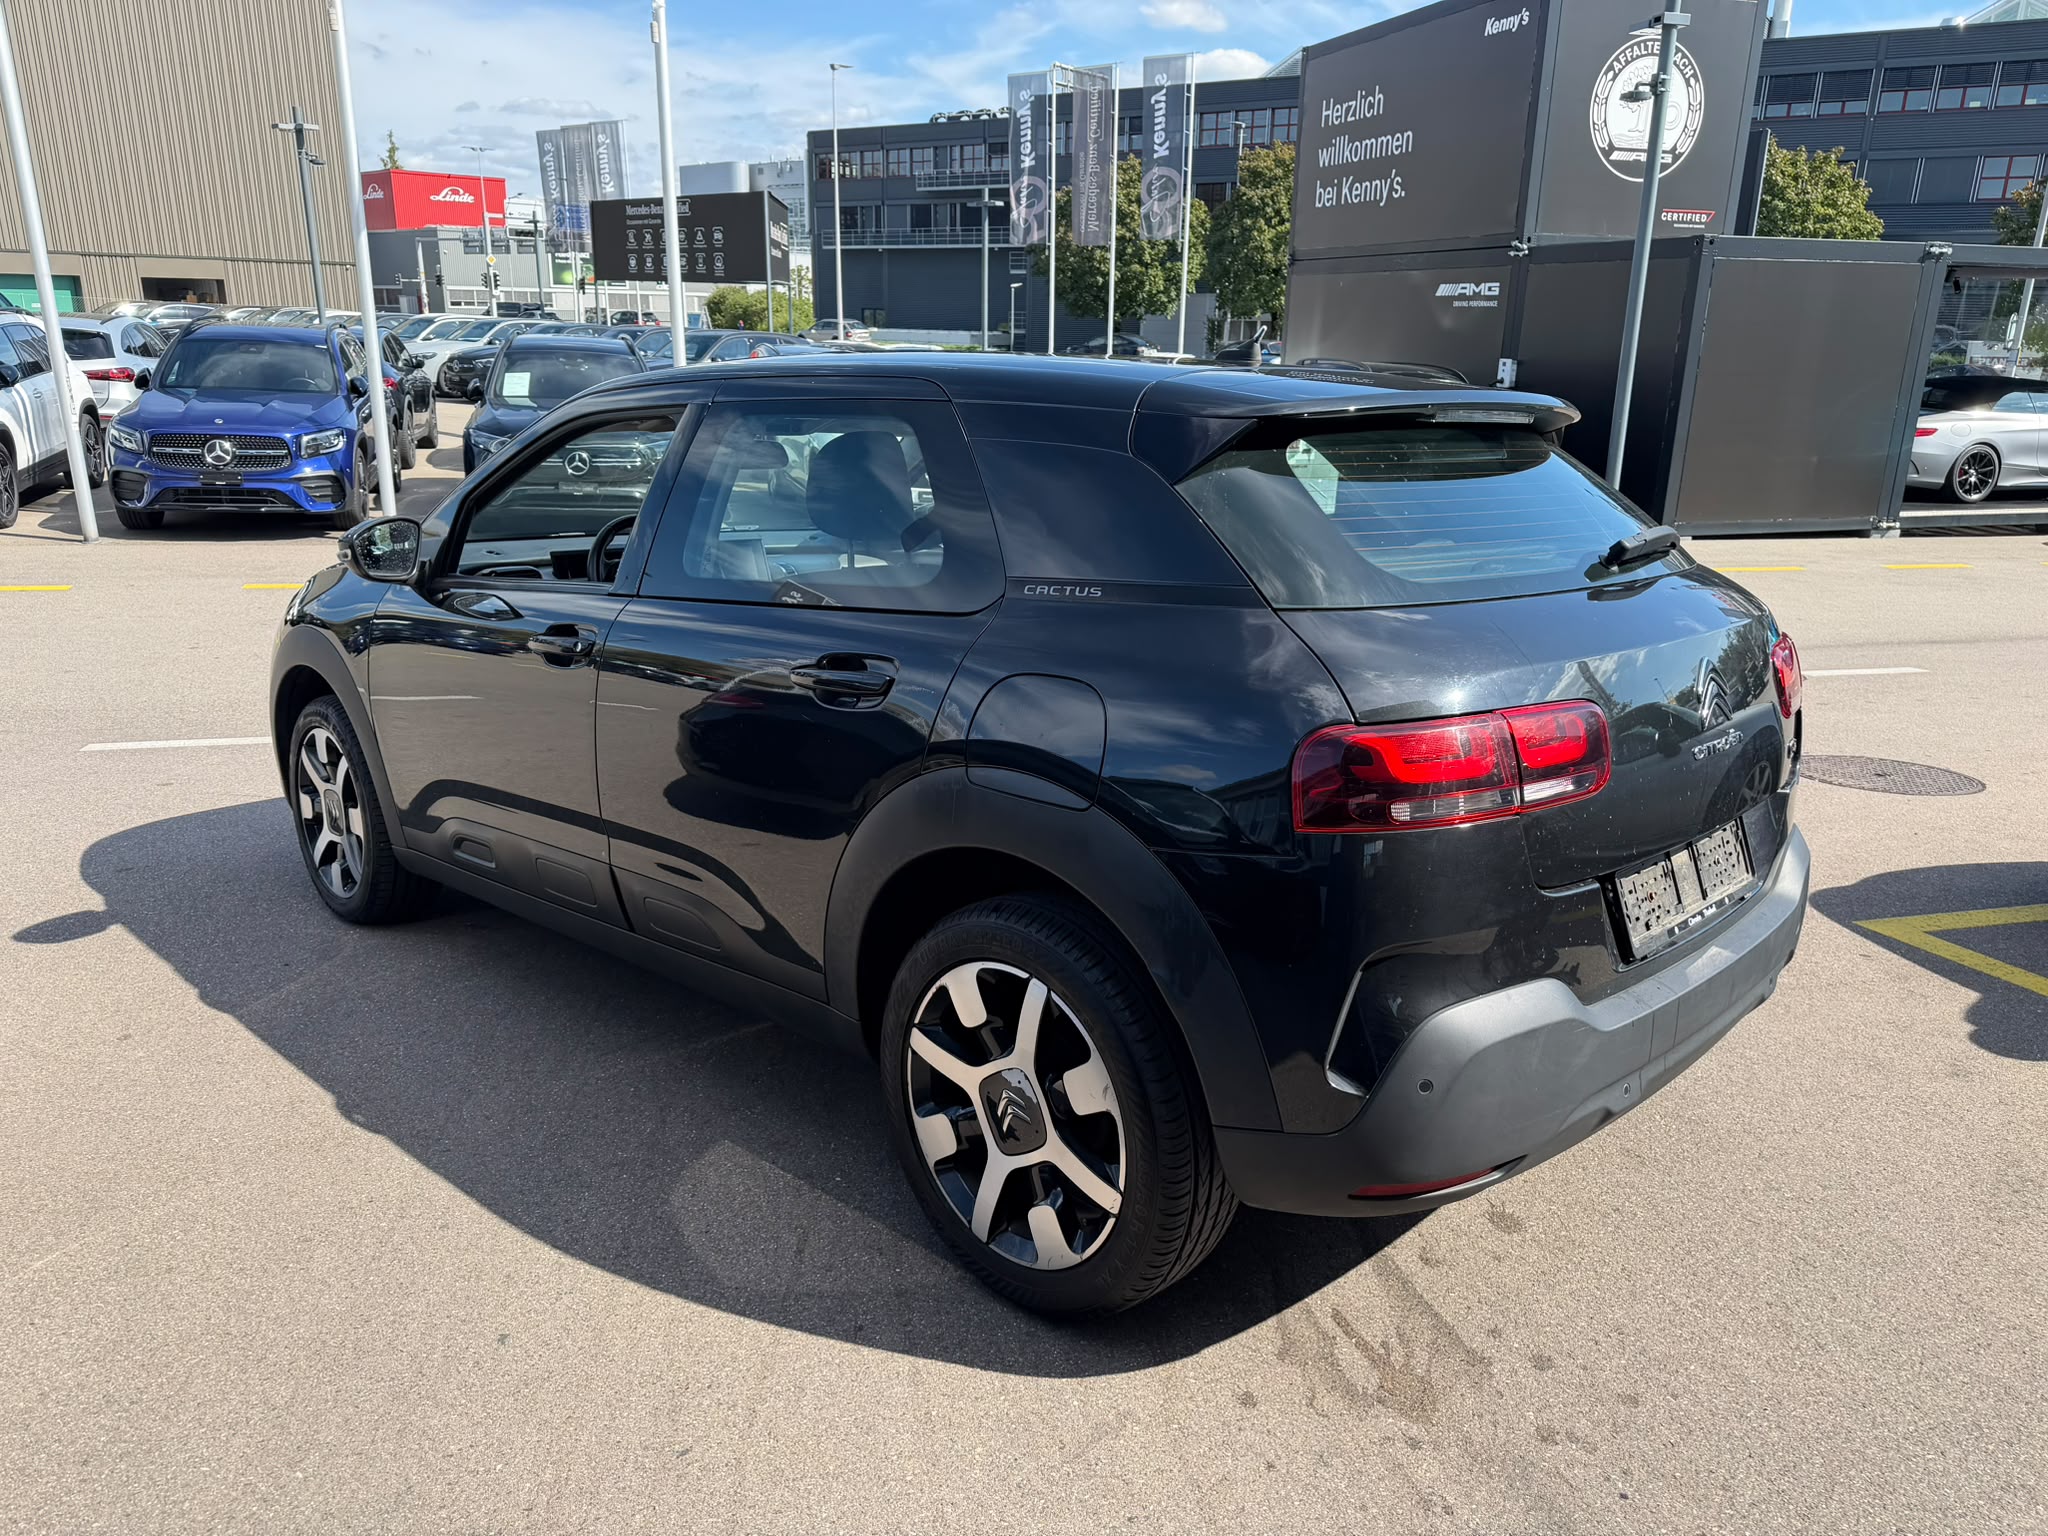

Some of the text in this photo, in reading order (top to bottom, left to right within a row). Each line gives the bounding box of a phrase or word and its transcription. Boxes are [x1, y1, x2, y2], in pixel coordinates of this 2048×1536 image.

[1484, 8, 1530, 36] Kenny's
[1612, 41, 1695, 79] AFFALTEACH
[1321, 85, 1384, 128] Herzlich
[1318, 130, 1413, 168] willkommen
[1631, 151, 1673, 163] AG
[363, 183, 385, 200] Linde
[429, 186, 476, 204] Linde
[1315, 169, 1406, 208] bei Kenny's.
[1661, 212, 1707, 222] CERTIFIED
[1456, 282, 1500, 296] AMG
[1023, 584, 1102, 597] CACTUS
